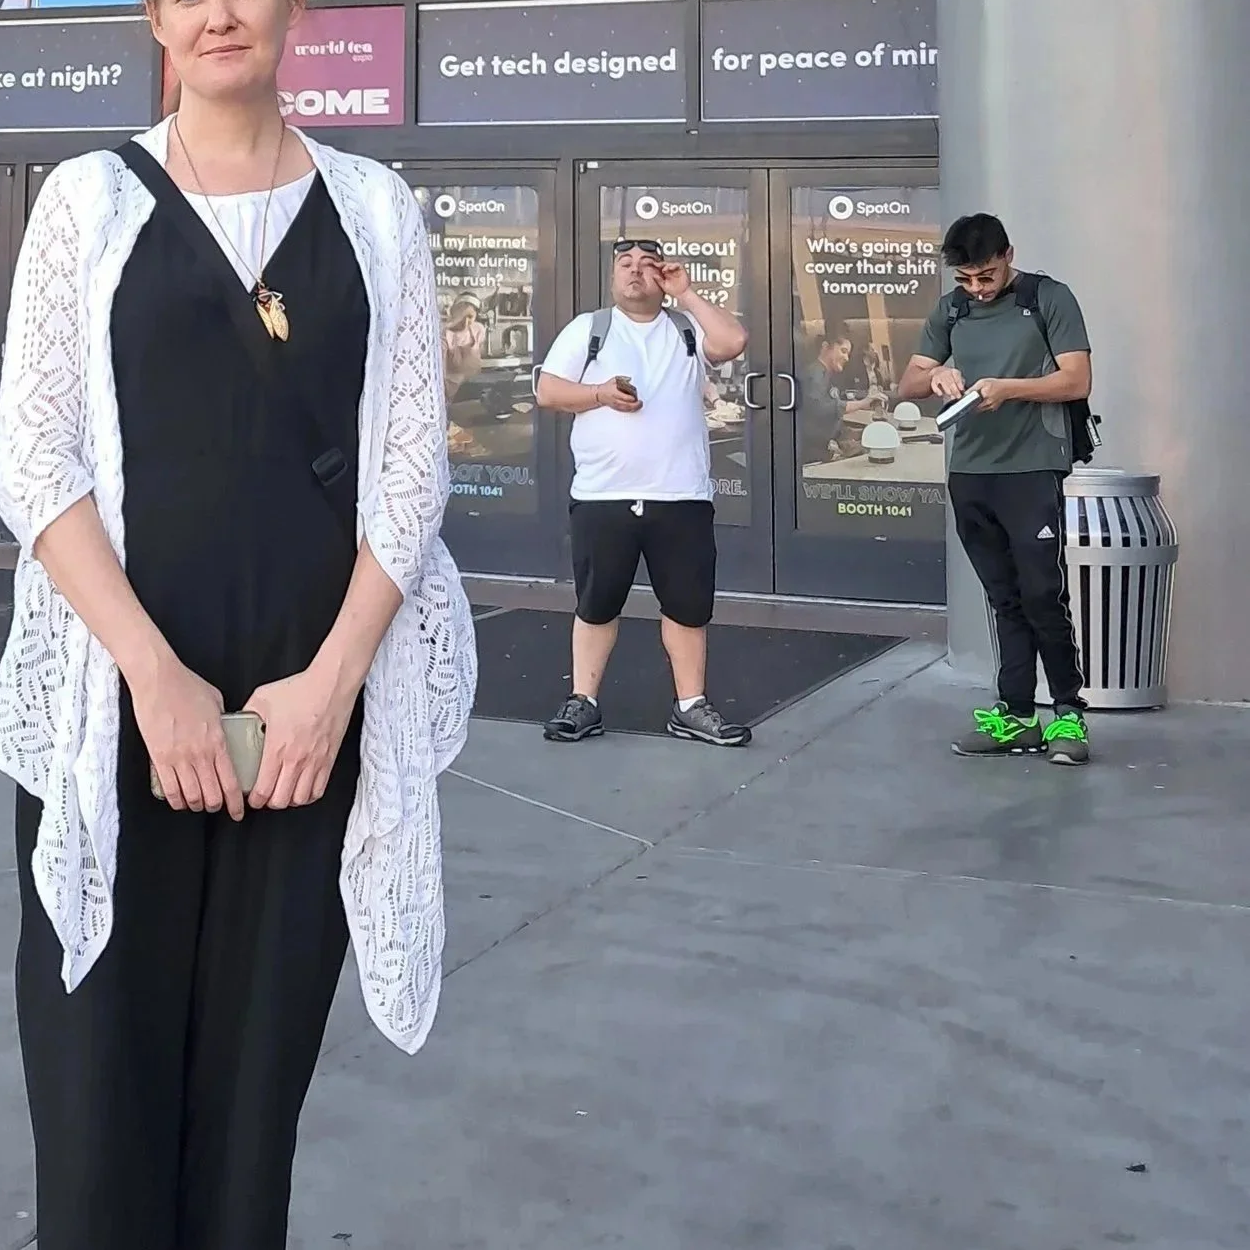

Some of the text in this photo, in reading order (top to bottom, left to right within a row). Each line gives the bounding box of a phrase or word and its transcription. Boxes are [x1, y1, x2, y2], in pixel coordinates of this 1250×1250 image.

[294, 38, 373, 56] world tea
[439, 48, 677, 79] Get tech designed
[712, 47, 753, 71] for
[759, 50, 847, 76] peace
[854, 42, 885, 66] of
[21, 67, 45, 88] at
[50, 63, 123, 93] night?
[276, 88, 390, 117] COME
[458, 200, 505, 215] SpotOn
[661, 201, 713, 217] SpotOn
[856, 201, 911, 217] SpotOn
[429, 233, 527, 251] ill my internet
[806, 238, 934, 257] Who's going to
[435, 253, 528, 271] down during
[805, 259, 937, 275] cover that shift
[436, 272, 504, 286] the rush?
[684, 263, 736, 288] illing
[822, 279, 919, 295] tomorrow?
[485, 465, 534, 485] YOU.
[448, 484, 503, 496] OOTH 1041
[838, 503, 912, 517] BOOTH 1041
